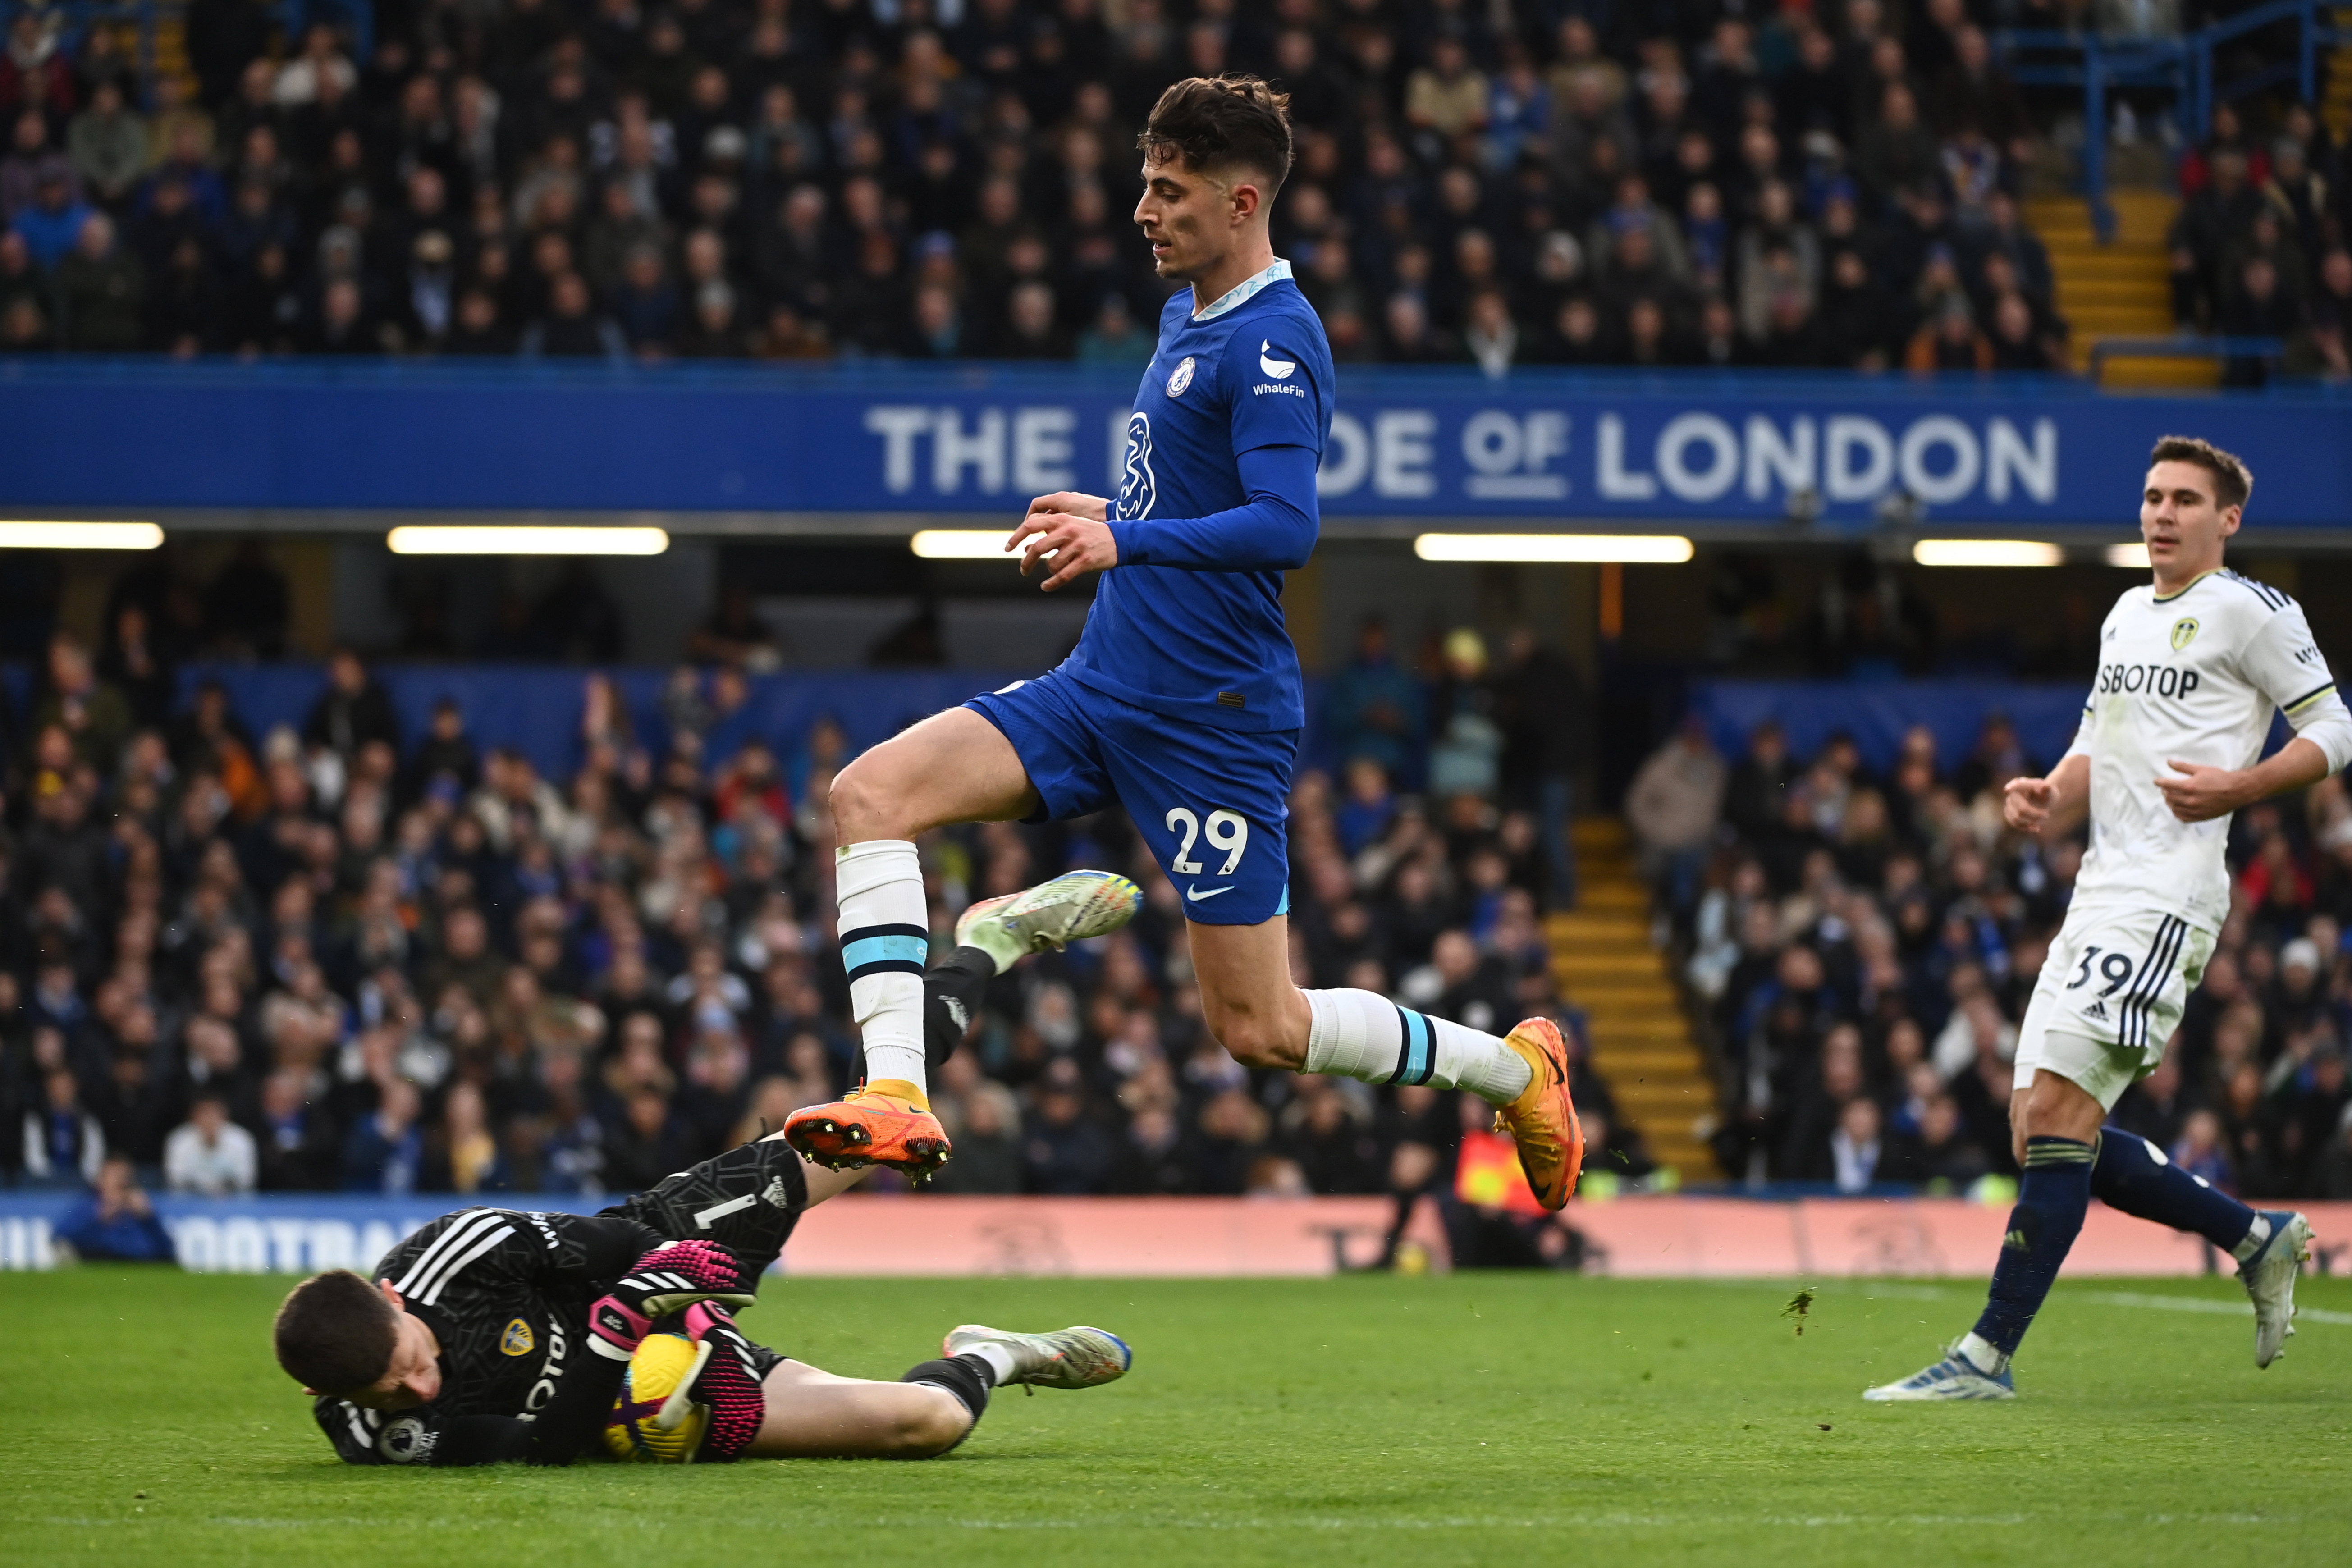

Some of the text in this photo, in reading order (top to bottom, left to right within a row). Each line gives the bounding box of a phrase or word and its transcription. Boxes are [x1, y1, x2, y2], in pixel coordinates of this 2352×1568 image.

[1253, 383, 1304, 398] WhaleFin
[865, 407, 1076, 496] THE
[1460, 408, 1572, 475] OF
[1596, 410, 2058, 504] LONDON
[2100, 664, 2199, 699] SBOTOP
[1166, 807, 1248, 875] 29
[2066, 946, 2132, 997] 39
[693, 1193, 757, 1230] 1
